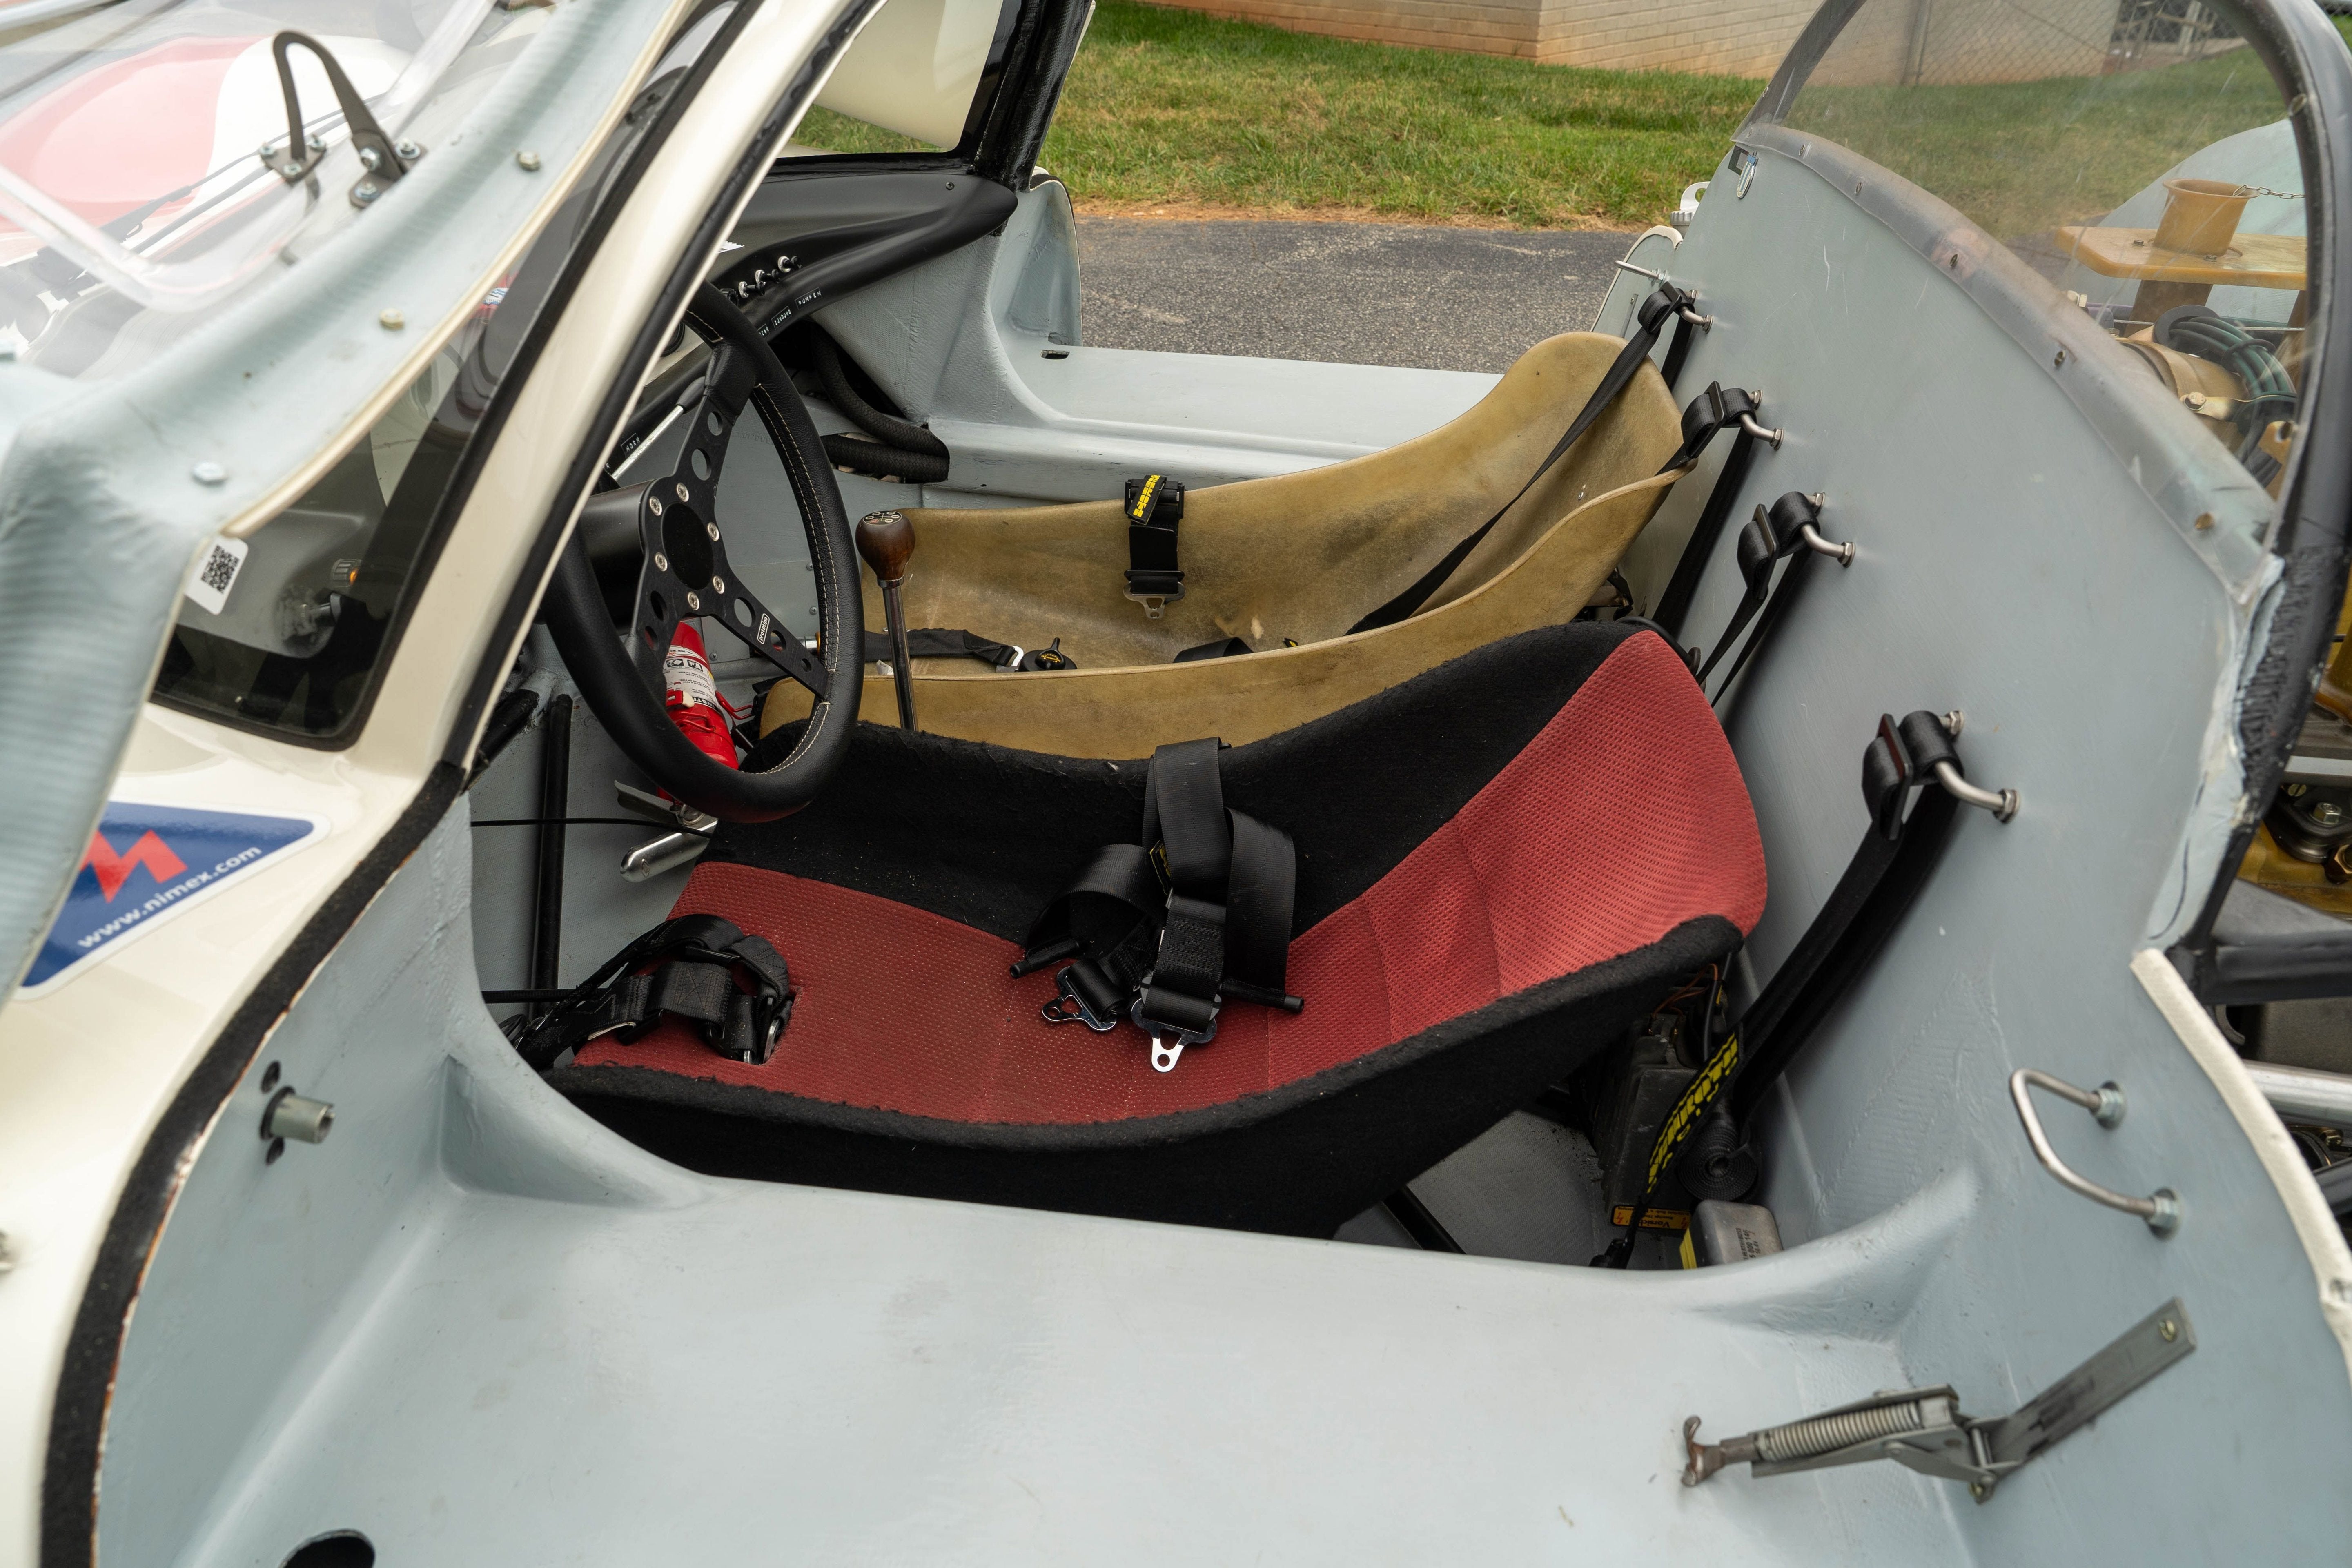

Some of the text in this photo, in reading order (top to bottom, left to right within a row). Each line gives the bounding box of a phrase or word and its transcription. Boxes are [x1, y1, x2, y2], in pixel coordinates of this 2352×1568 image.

[798, 290, 822, 306] PUMPEN
[626, 437, 640, 452] HORN
[759, 616, 768, 642] prototipo
[78, 846, 262, 948] www.nimex.com
